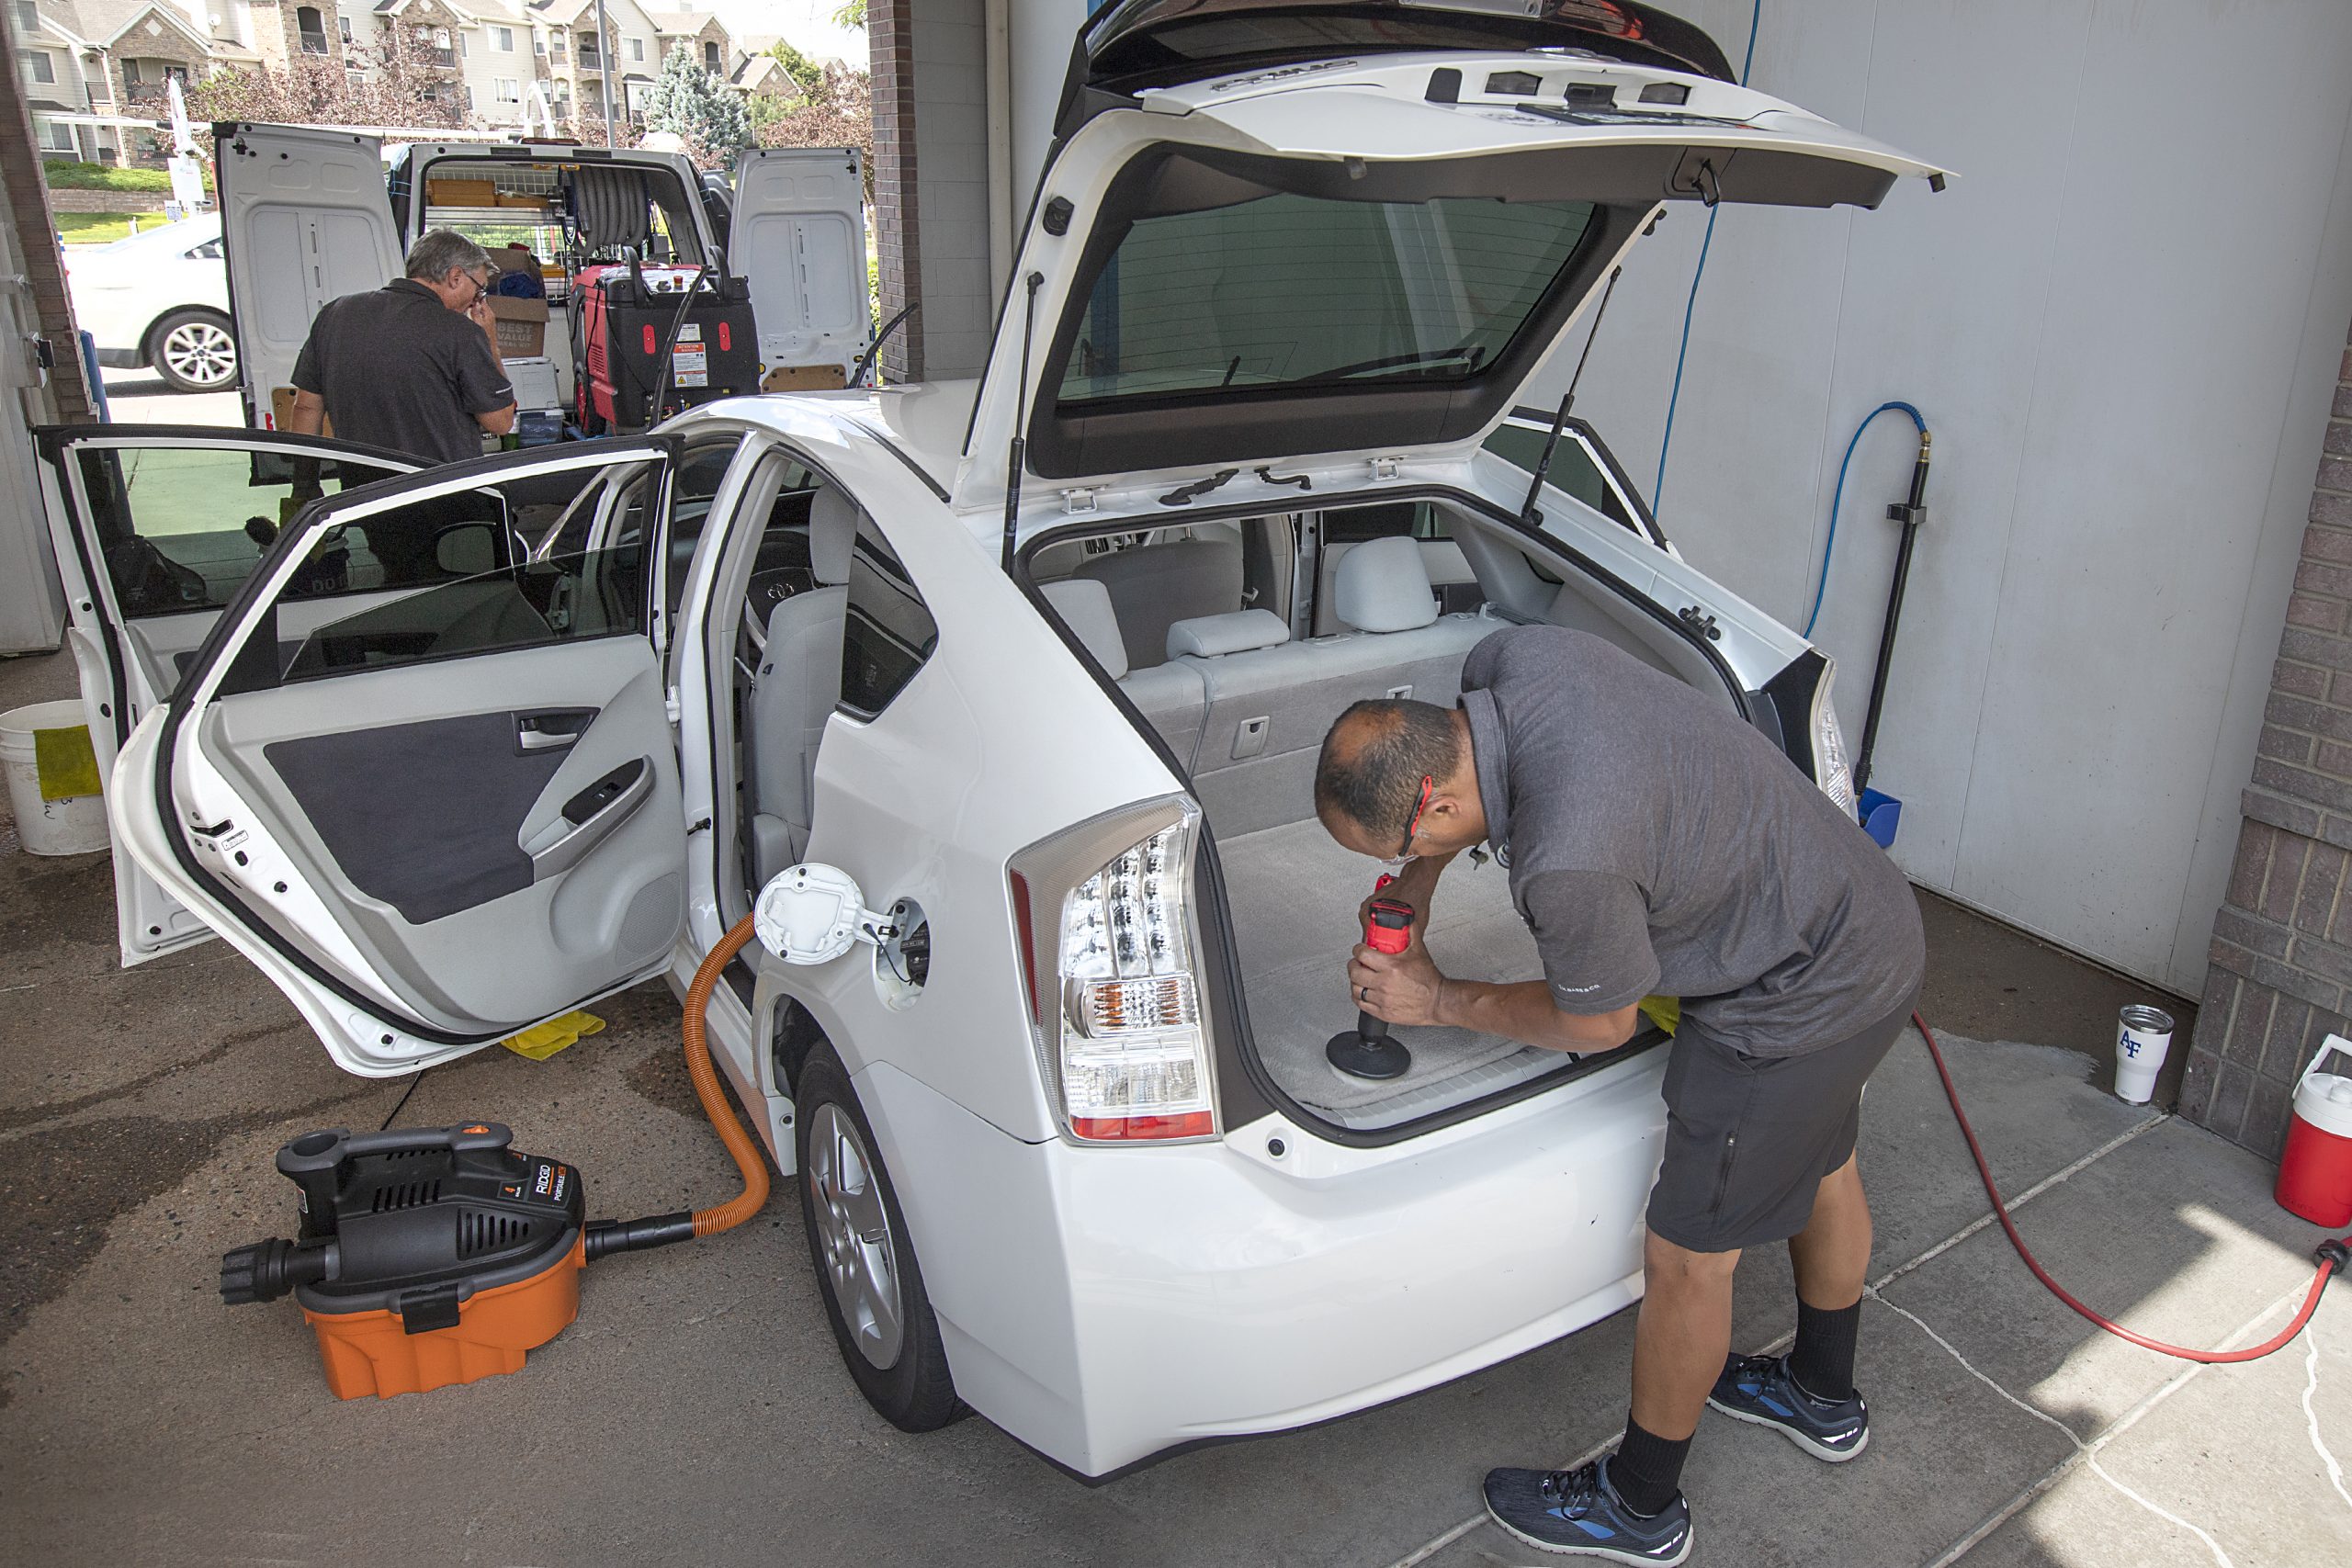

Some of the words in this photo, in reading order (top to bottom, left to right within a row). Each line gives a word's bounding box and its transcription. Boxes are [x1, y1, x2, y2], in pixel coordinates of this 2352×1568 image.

[497, 321, 533, 333] BEST
[497, 333, 533, 342] VALUE
[2120, 1030, 2142, 1058] AF
[536, 1165, 551, 1194] RIDGID
[553, 1175, 565, 1201] PORTABLE
